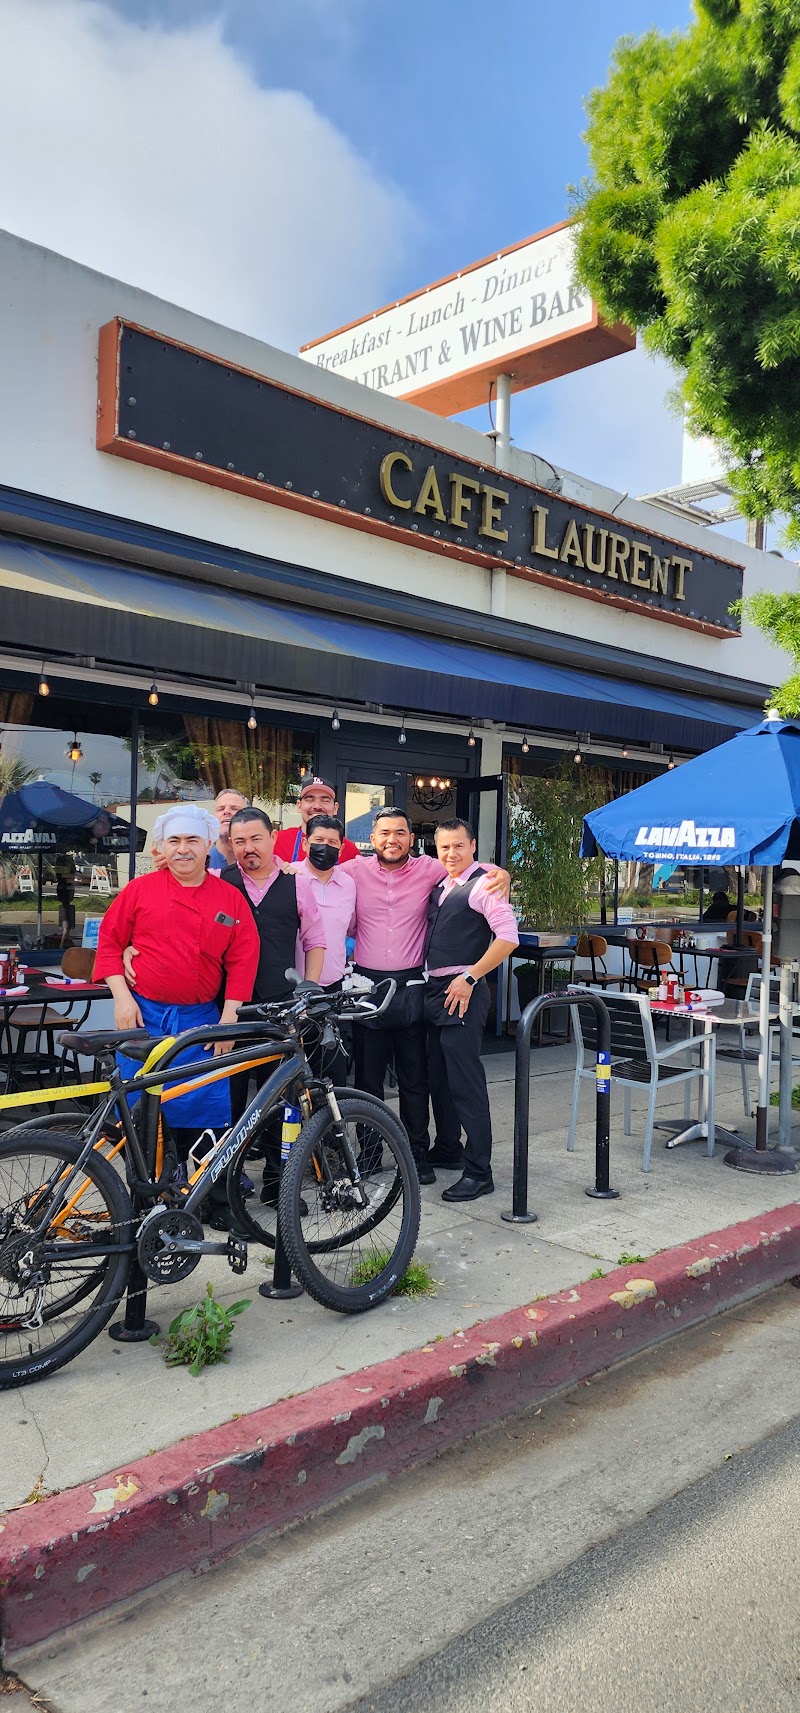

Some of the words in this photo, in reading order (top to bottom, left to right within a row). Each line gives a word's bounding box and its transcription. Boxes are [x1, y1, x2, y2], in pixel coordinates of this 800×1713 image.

[317, 325, 391, 370] Breakfast
[406, 291, 465, 337] Lunch
[482, 254, 557, 304] Dinner
[438, 339, 452, 365] &
[459, 306, 523, 355] WINE
[530, 284, 584, 328] BAR
[379, 451, 509, 542] CAFE
[531, 505, 693, 601] LAURENT
[634, 820, 735, 847] LAVAZZA
[598, 1053, 605, 1063] P
[284, 1107, 292, 1121] P
[210, 1125, 249, 1183] FUJI
[29, 1359, 51, 1374] COMP
